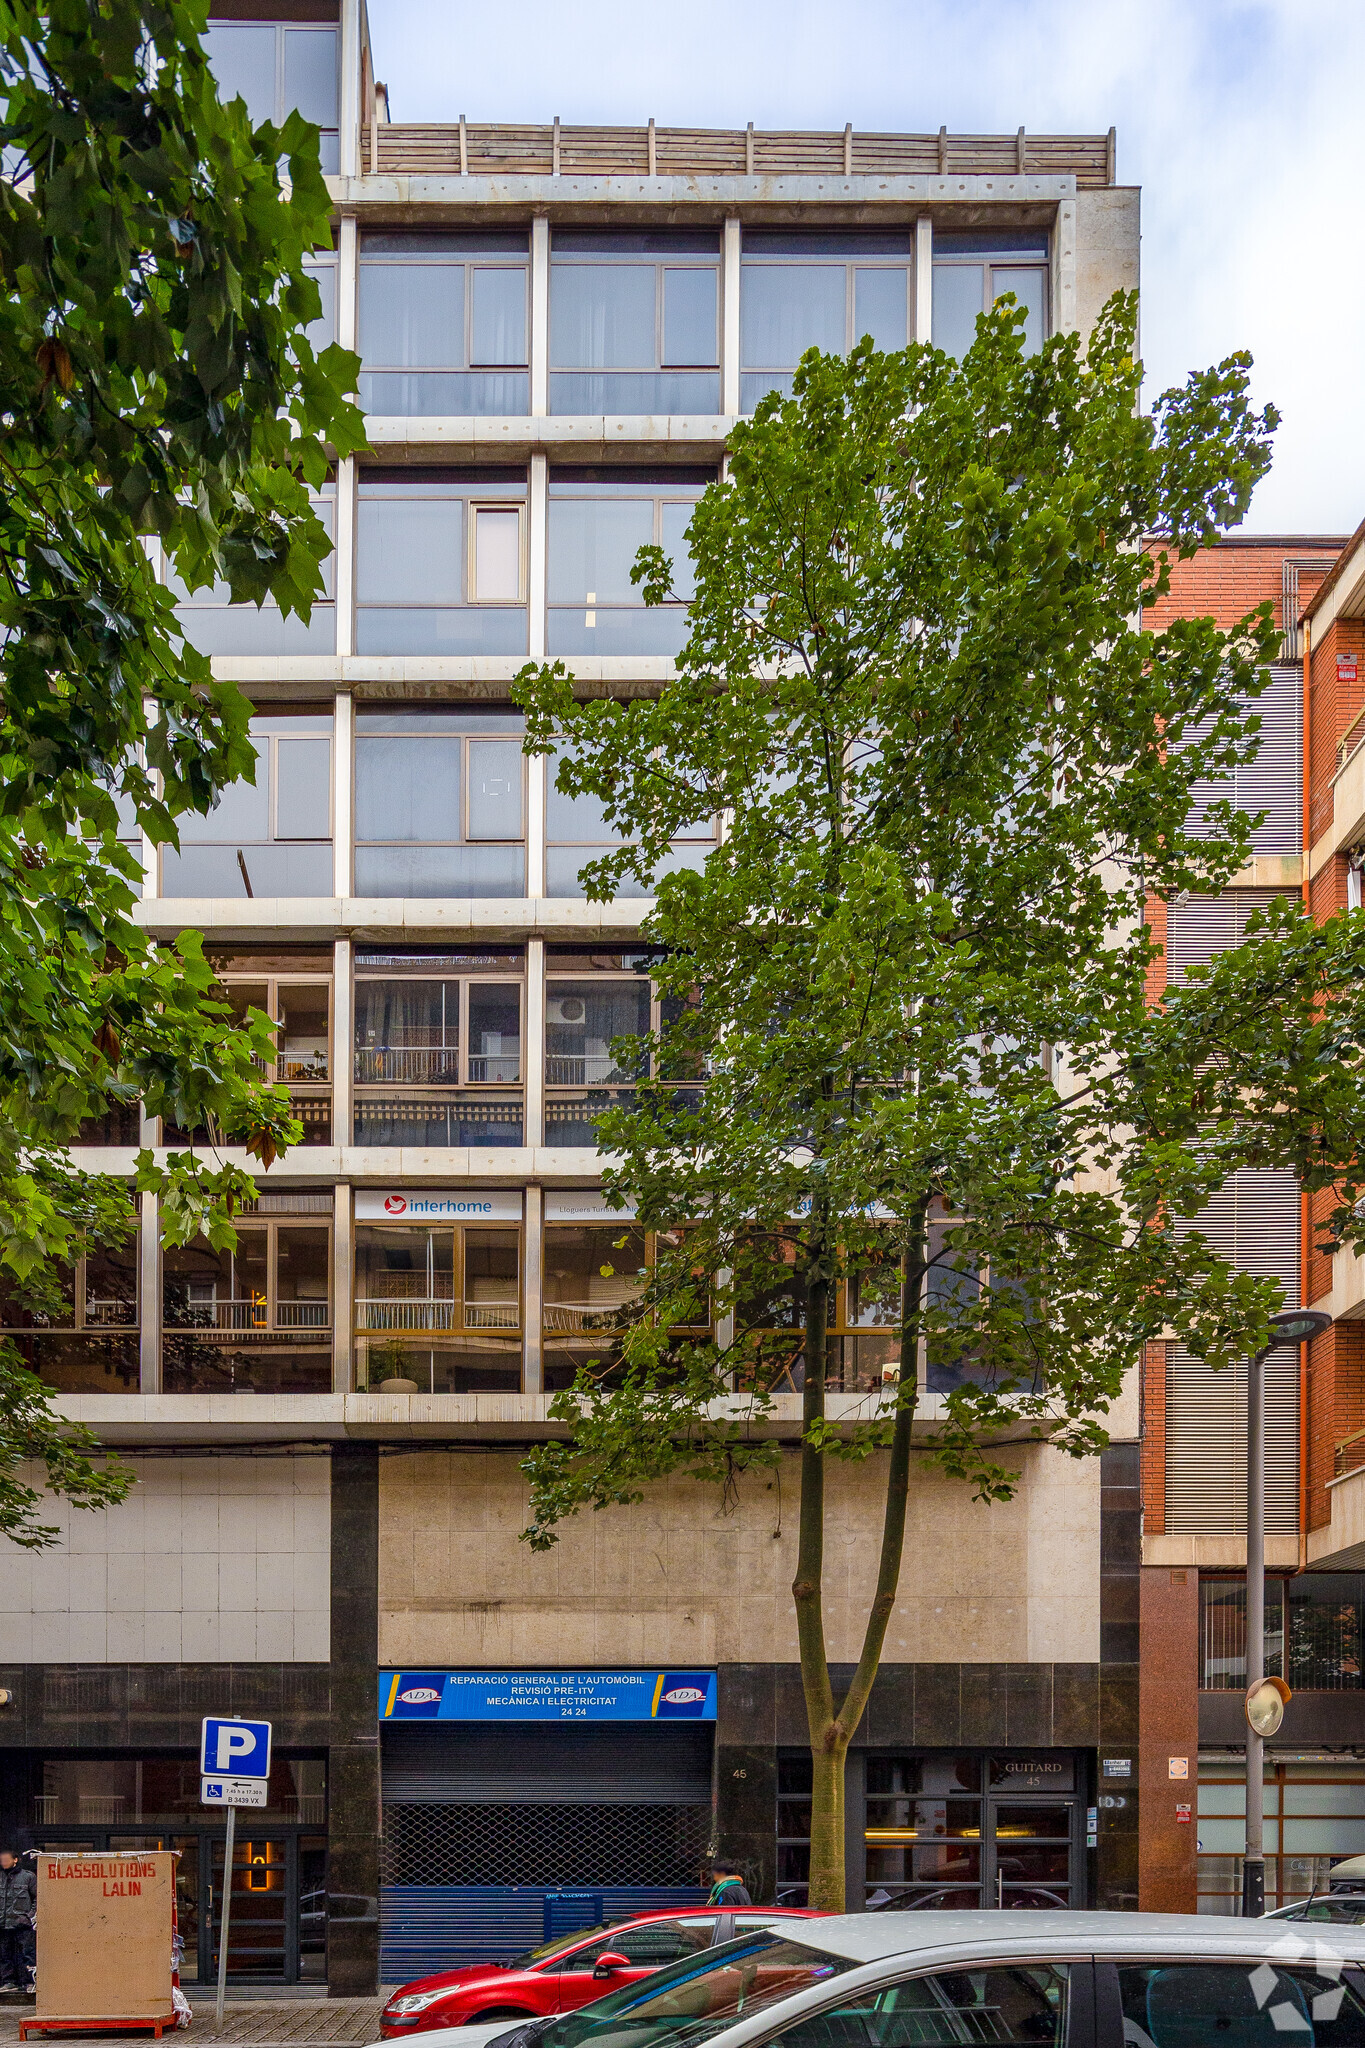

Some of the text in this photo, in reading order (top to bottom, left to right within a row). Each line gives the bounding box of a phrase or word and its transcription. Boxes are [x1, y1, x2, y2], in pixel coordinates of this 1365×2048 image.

[410, 1199, 492, 1213] interhome
[560, 1206, 591, 1214] Lloguers
[450, 1675, 645, 1685] REPARACIÓ GENERAL DE L'AUTOMÒBIL
[511, 1685, 594, 1695] REVISIÓ PRE-ITV
[403, 1692, 434, 1700] ADA
[486, 1696, 540, 1705] MECÀNICA
[547, 1697, 617, 1706] ELECTRICITAT
[668, 1692, 698, 1700] ADA
[561, 1708, 587, 1717] 24 24
[216, 1725, 257, 1770] P
[1005, 1763, 1062, 1773] GUITARD
[732, 1769, 747, 1779] 45
[1026, 1776, 1041, 1786] 45
[48, 1862, 156, 1879] GLASSOLUTIONS
[103, 1881, 142, 1897] LALIN
